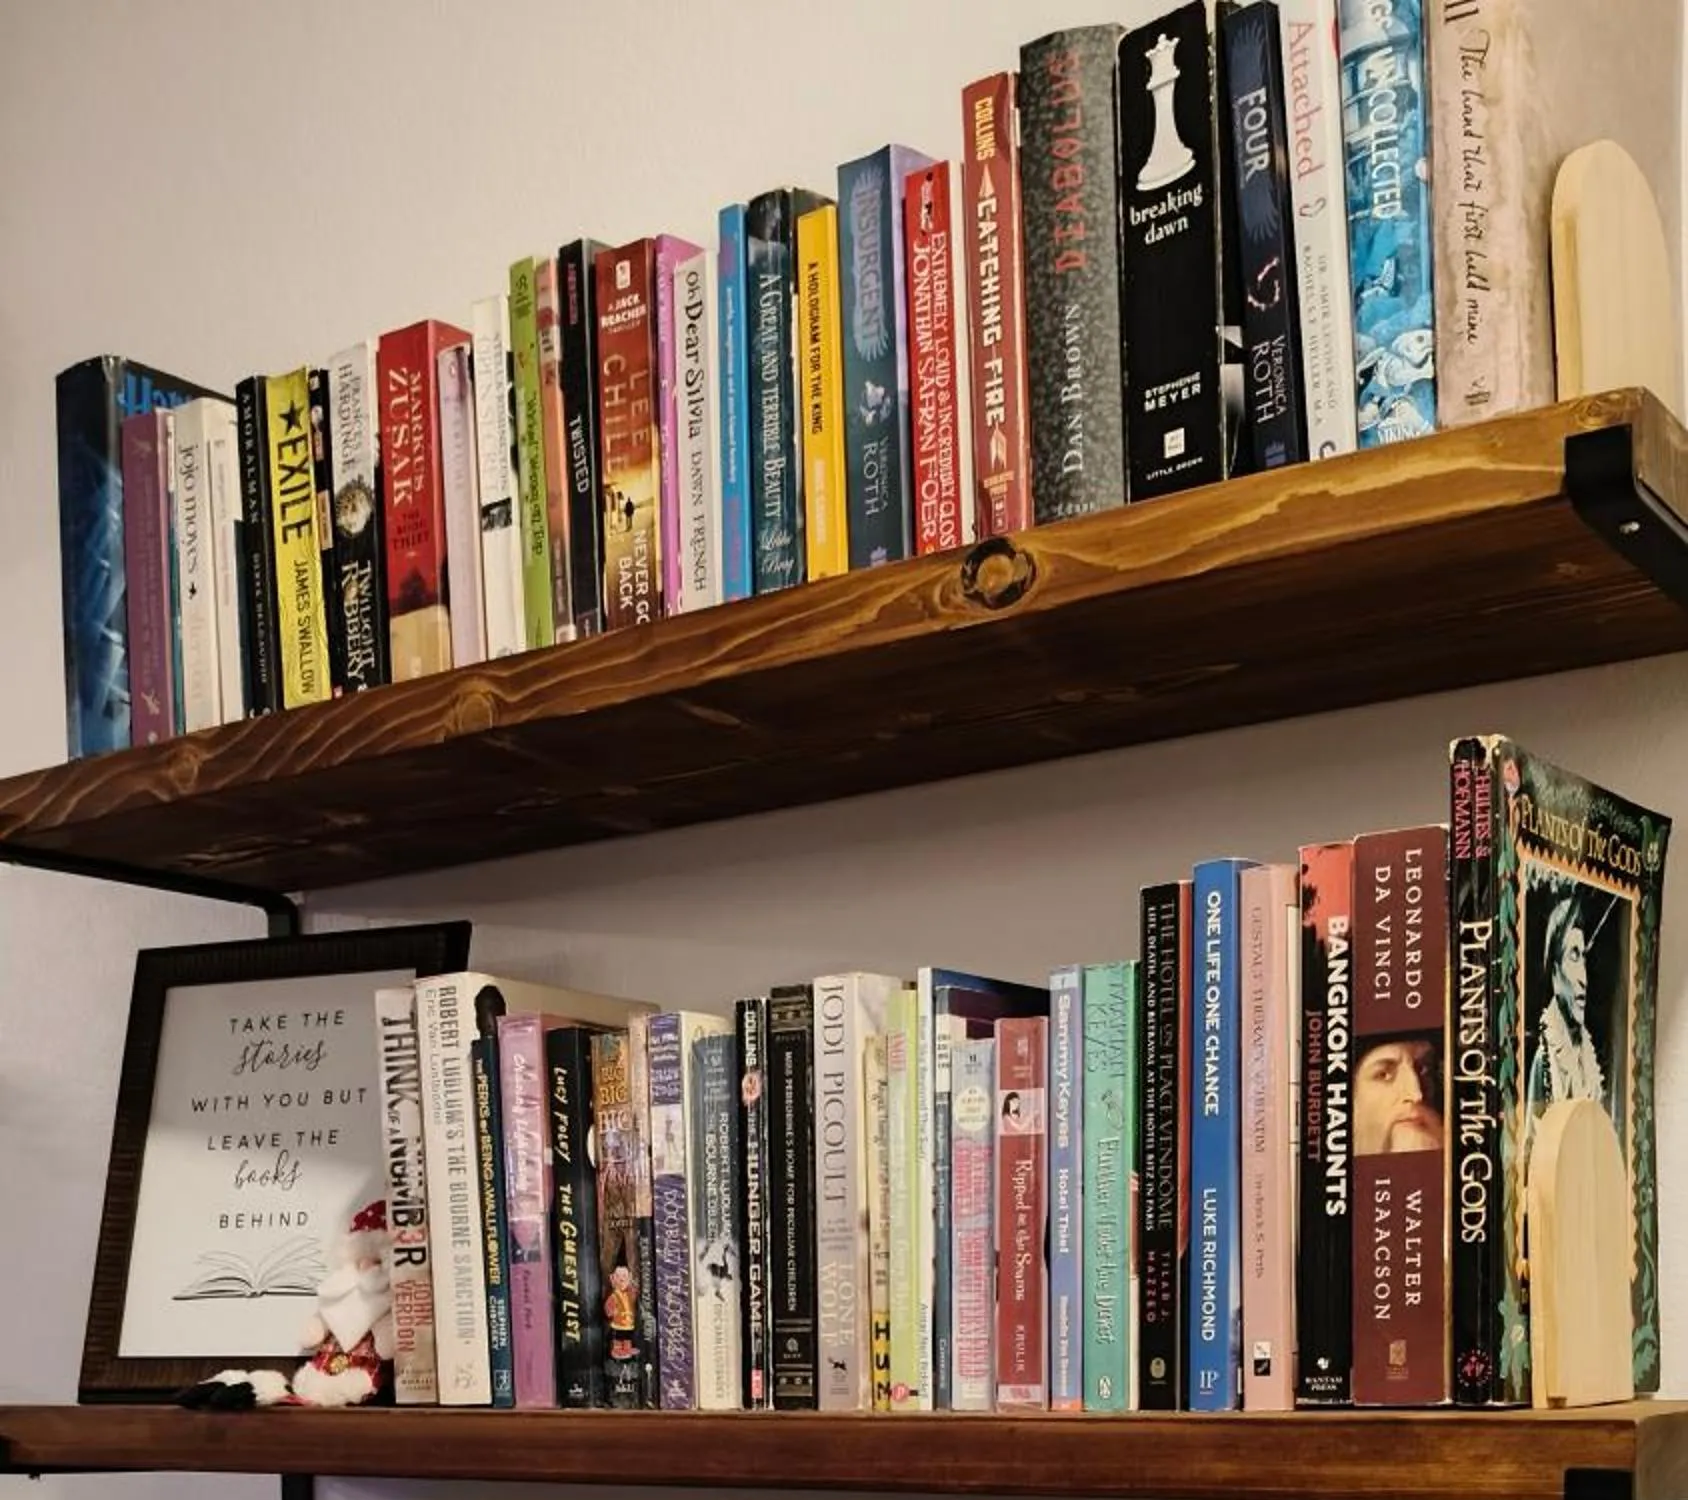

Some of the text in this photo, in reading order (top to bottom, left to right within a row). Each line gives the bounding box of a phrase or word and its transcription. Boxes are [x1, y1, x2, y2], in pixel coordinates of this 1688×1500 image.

[1238, 88, 1269, 182] FOUR
[1287, 21, 1323, 178] Attached
[1129, 183, 1202, 225] breaking
[1145, 215, 1188, 244] dawn
[974, 97, 1006, 426] COLLINS CATCHING FIRE
[808, 262, 823, 434] A HOLOGRAM FOR THE KING
[1252, 343, 1274, 424] ROTH
[1269, 336, 1286, 417] VERONICA
[388, 366, 412, 507] ZUSAK
[408, 371, 424, 492] MARKUS
[630, 370, 649, 448] LEE
[684, 271, 707, 591] Oh Dear Silvia DAWN FRENCH
[1145, 383, 1201, 411] MEYER
[277, 437, 313, 544] EXILE
[569, 416, 589, 493] TWISTED
[863, 443, 880, 516] ROTH
[619, 557, 633, 609] BACK
[293, 560, 315, 694] JAMES SWALLOW
[1454, 758, 1471, 859] HOFMANN
[1159, 898, 1175, 943] THE
[1376, 866, 1391, 1000] DA VINCI
[1405, 848, 1422, 1009] LEONARDO
[230, 1010, 345, 1034] TAKE THE
[1160, 944, 1173, 1020] HOTEL
[1204, 891, 1221, 1116] ONE LIFE ONE CHANCE
[232, 1038, 326, 1075] stories
[822, 984, 848, 1206] JODI PICOULT
[1160, 1054, 1174, 1114] PLACE
[1306, 1010, 1322, 1161] JOHN BURDETT
[1326, 916, 1348, 1216] BANGKOK HAUNTS
[192, 1088, 367, 1112] WITH YOU BUT
[208, 1129, 339, 1151] LEAVE THE
[1056, 994, 1071, 1253] Sammy Keyes Hotel Thief
[234, 1151, 302, 1190] books
[553, 1067, 580, 1341] LUCY FOLEY THE GUEST LIST
[786, 1149, 796, 1179] HOME
[786, 1183, 796, 1204] FOR
[1160, 1120, 1174, 1230] VENDÔME
[219, 1212, 309, 1229] BEHIND
[1375, 1178, 1392, 1320] ISAACSON
[1404, 1189, 1422, 1306] WALTER
[413, 1280, 432, 1326] JOHN
[787, 1260, 798, 1311] CHILDREN
[1203, 1188, 1217, 1341] LUKE RICHMOND
[394, 1280, 415, 1352] VERDON
